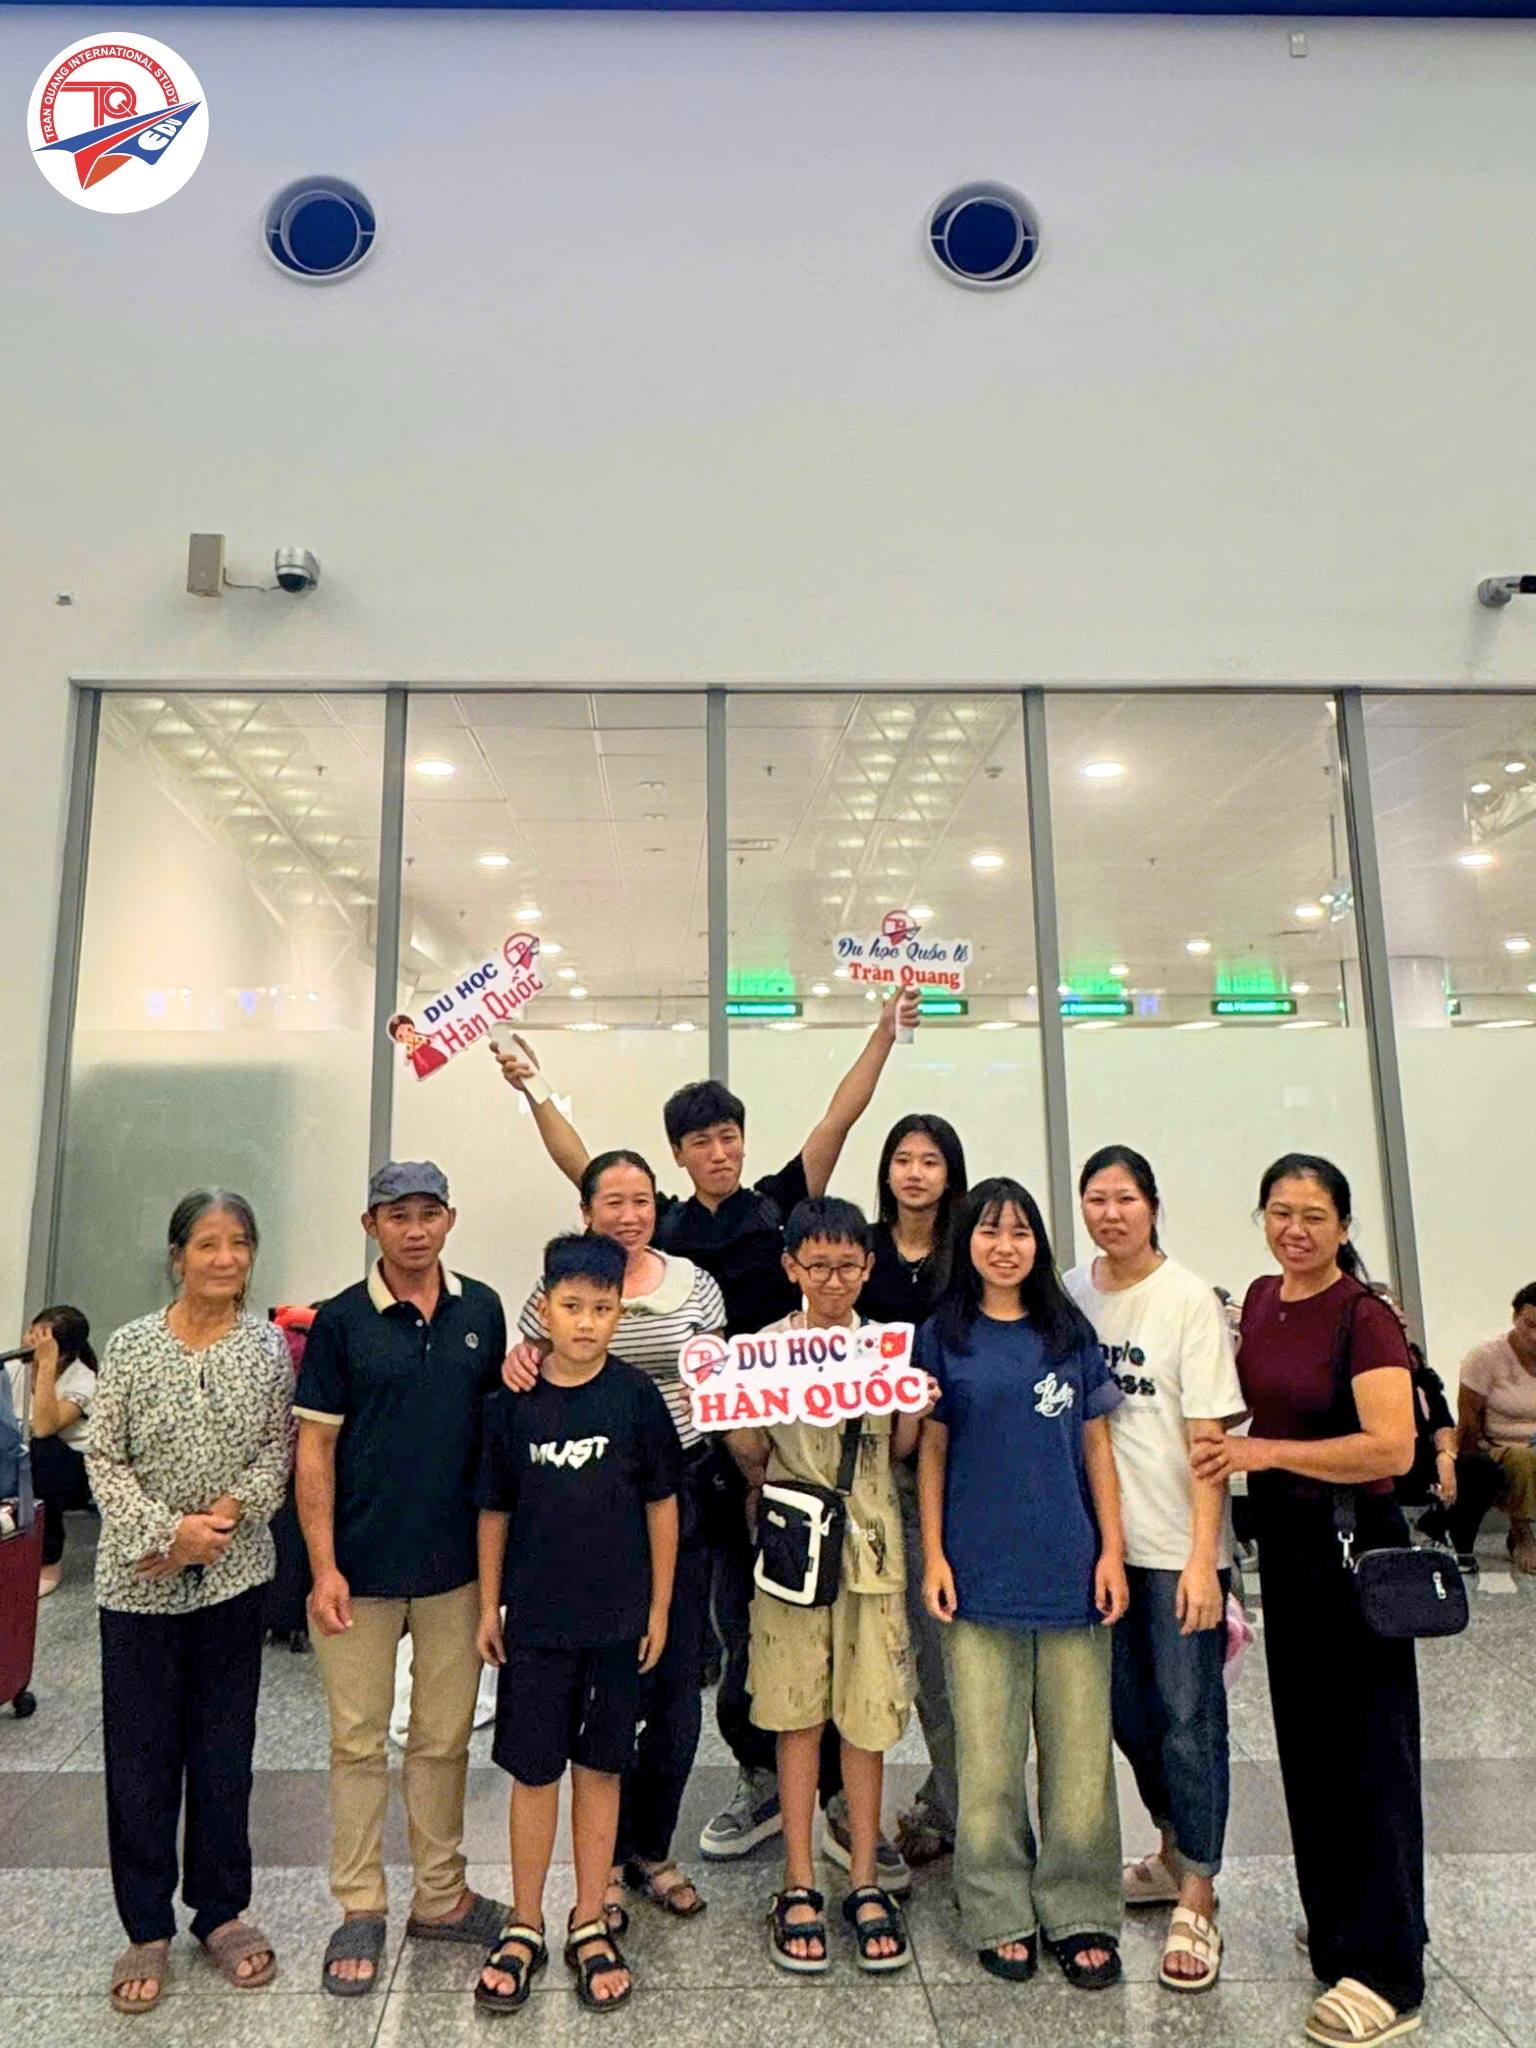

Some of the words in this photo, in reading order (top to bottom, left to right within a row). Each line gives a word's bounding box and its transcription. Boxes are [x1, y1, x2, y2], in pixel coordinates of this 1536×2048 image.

[423, 994, 455, 1023] DU
[455, 962, 499, 999] HỌC
[899, 964, 961, 990] Quang
[431, 1013, 491, 1055] Hàn
[481, 968, 544, 1021] Quốc
[736, 1338, 778, 1371] DU
[787, 1333, 847, 1373] HỌC
[697, 1382, 790, 1423] HÀN
[803, 1363, 922, 1420] QUỐC
[528, 1435, 610, 1470] MUST
